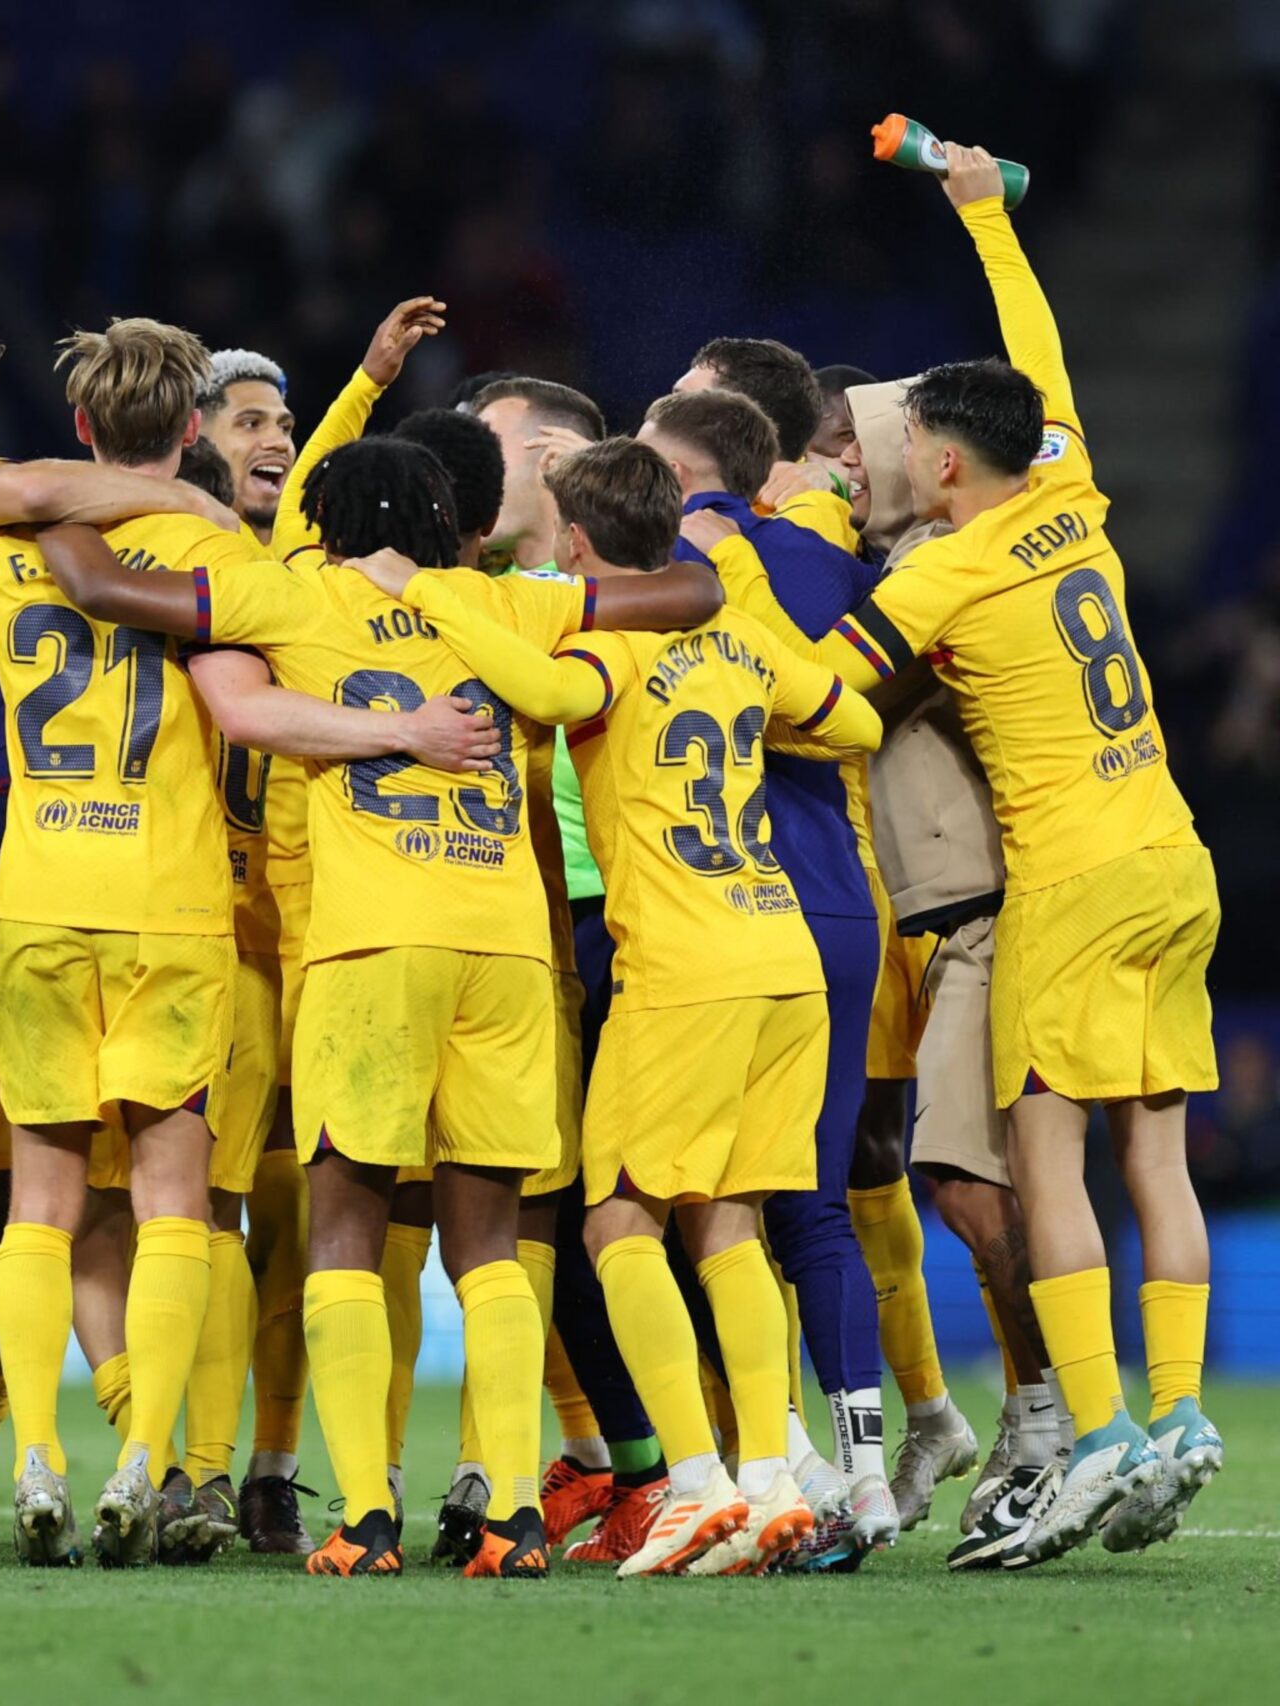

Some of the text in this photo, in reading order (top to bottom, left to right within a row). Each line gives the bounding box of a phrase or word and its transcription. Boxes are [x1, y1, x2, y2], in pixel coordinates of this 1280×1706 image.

[1009, 511, 1088, 571] PEDRI
[9, 553, 38, 586] F.
[646, 633, 705, 705] PABLO
[1051, 568, 1149, 741] 8
[7, 603, 167, 785] 21
[655, 705, 783, 878] 32
[77, 814, 139, 830] ACNUR
[81, 800, 140, 817] UNHCR
[444, 830, 505, 851] UNHCR
[444, 844, 505, 866] ACNUR
[753, 883, 790, 899] UNHCR
[756, 898, 798, 911] ACNUR
[831, 1391, 854, 1475] TAPEDESIGN
